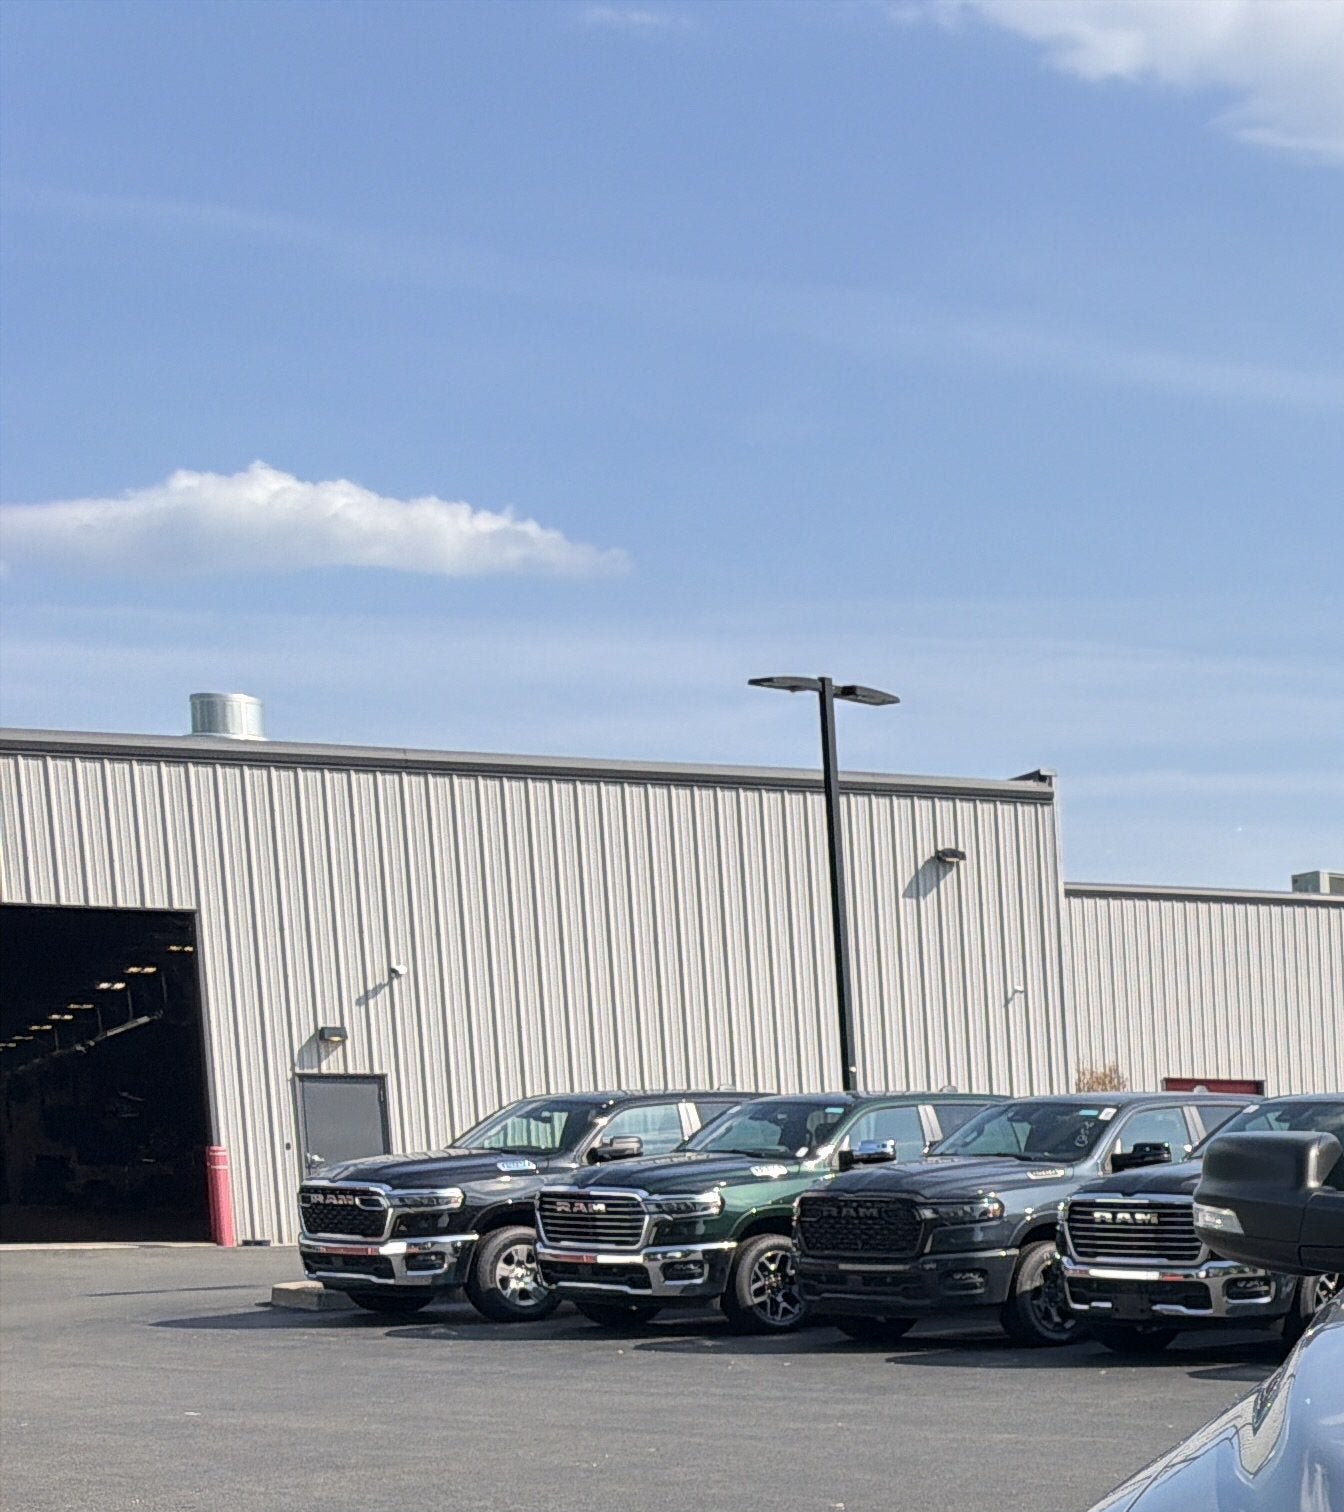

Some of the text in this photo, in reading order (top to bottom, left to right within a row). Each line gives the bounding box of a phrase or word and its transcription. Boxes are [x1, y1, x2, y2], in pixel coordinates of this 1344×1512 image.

[310, 1194, 354, 1205] RAM
[556, 1201, 607, 1213] RAM
[822, 1207, 879, 1218] RAM
[1093, 1211, 1159, 1224] RAM
